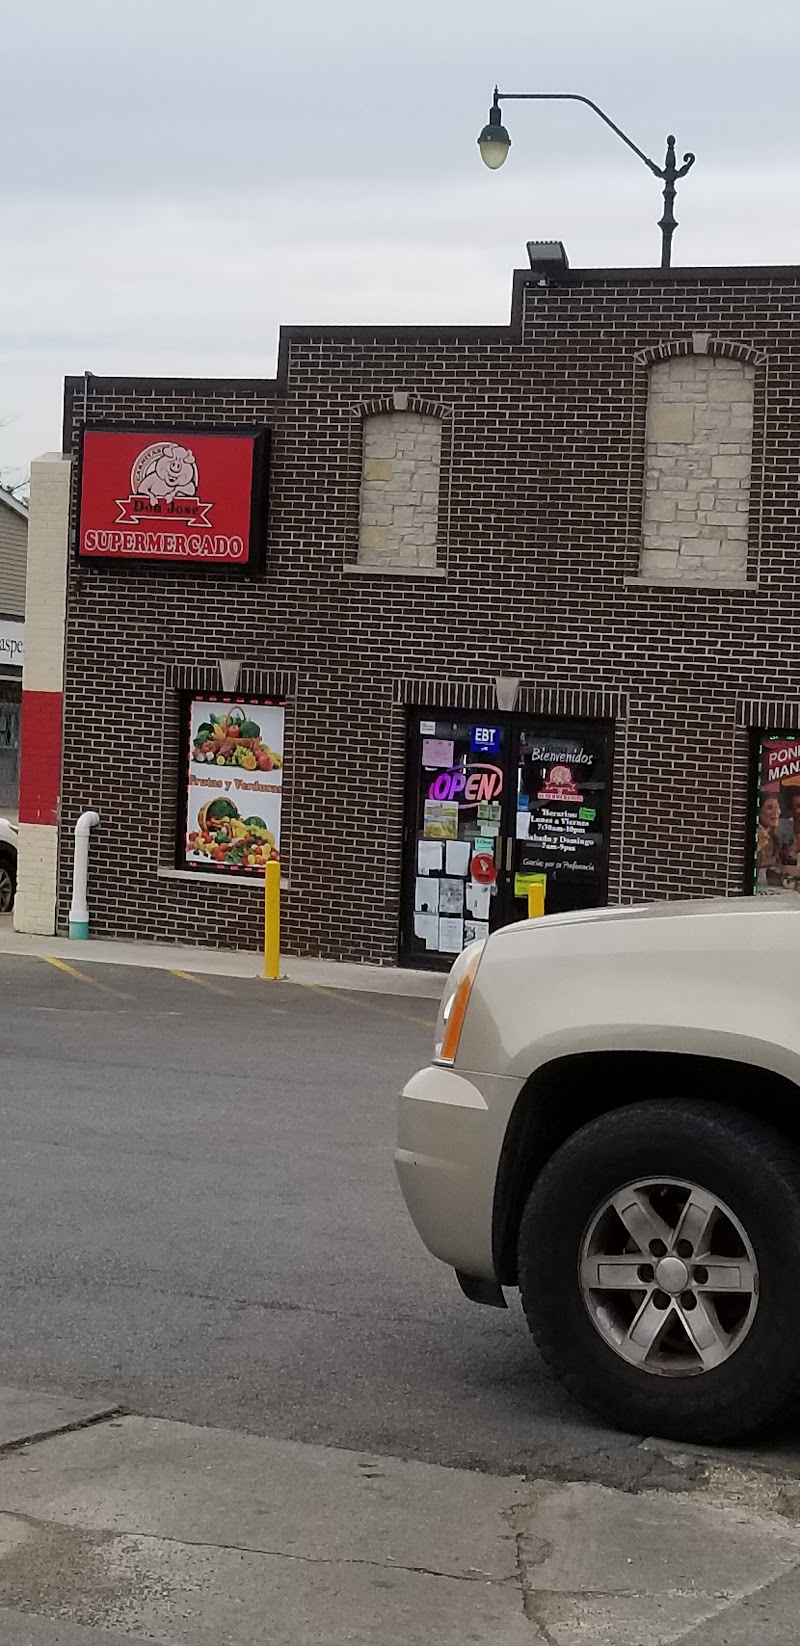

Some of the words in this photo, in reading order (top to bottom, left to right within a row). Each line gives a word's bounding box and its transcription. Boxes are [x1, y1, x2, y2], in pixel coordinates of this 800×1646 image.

[135, 448, 163, 482] CARNITAS
[133, 500, 162, 513] Don
[84, 530, 244, 558] SUPERMERCADO
[475, 727, 496, 743] EBT
[531, 747, 594, 765] Bienvenidos
[189, 774, 223, 788] Frutas
[224, 780, 232, 791] y
[234, 778, 283, 794] Verduras
[434, 772, 497, 801] OPEN
[531, 815, 553, 824] Lunes
[561, 817, 590, 827] Viernes
[537, 823, 586, 834] 7:30am-10pm
[541, 842, 576, 852] 7am-9pm
[559, 836, 595, 846] Domingo
